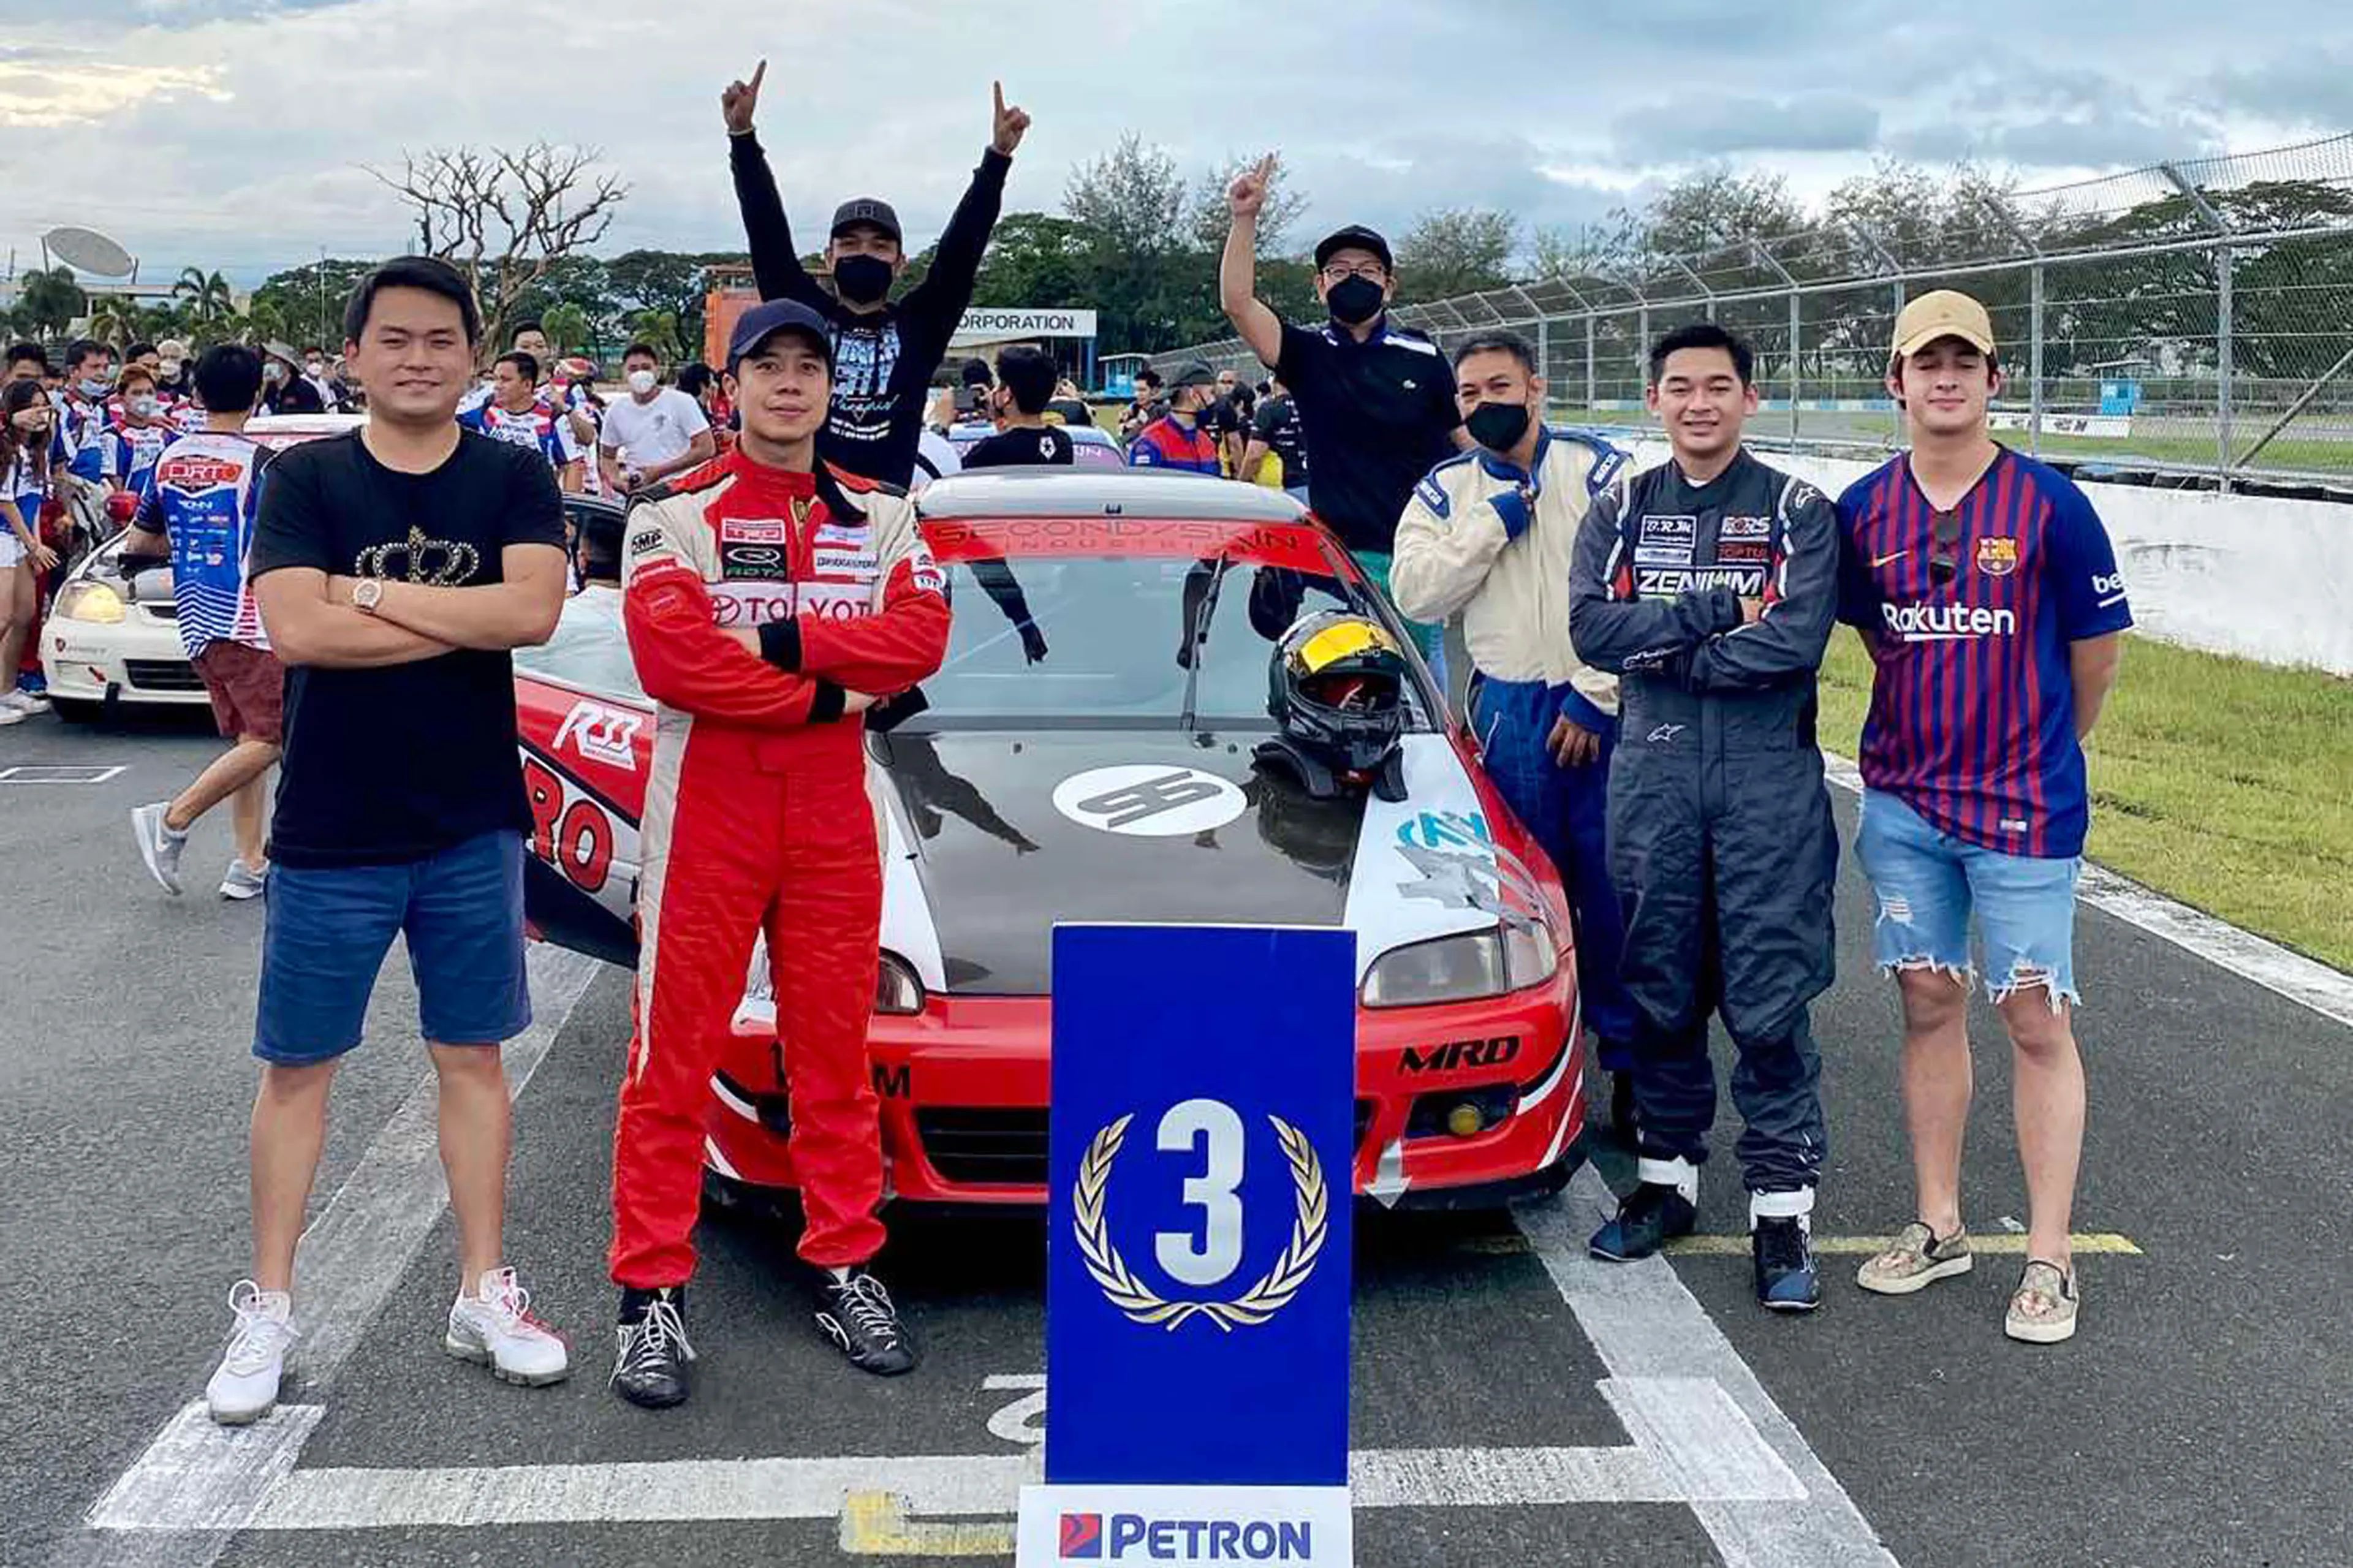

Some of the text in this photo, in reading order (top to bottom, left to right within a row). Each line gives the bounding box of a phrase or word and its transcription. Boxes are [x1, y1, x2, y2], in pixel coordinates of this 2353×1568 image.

[957, 315, 1074, 330] ORPORATION
[2091, 573, 2124, 594] be
[745, 597, 873, 624] TOYOT
[1881, 600, 2015, 635] Rakuten
[1398, 1036, 1520, 1074] MRD
[1155, 1099, 1245, 1286] 3
[1110, 1514, 1311, 1559] PETRON
